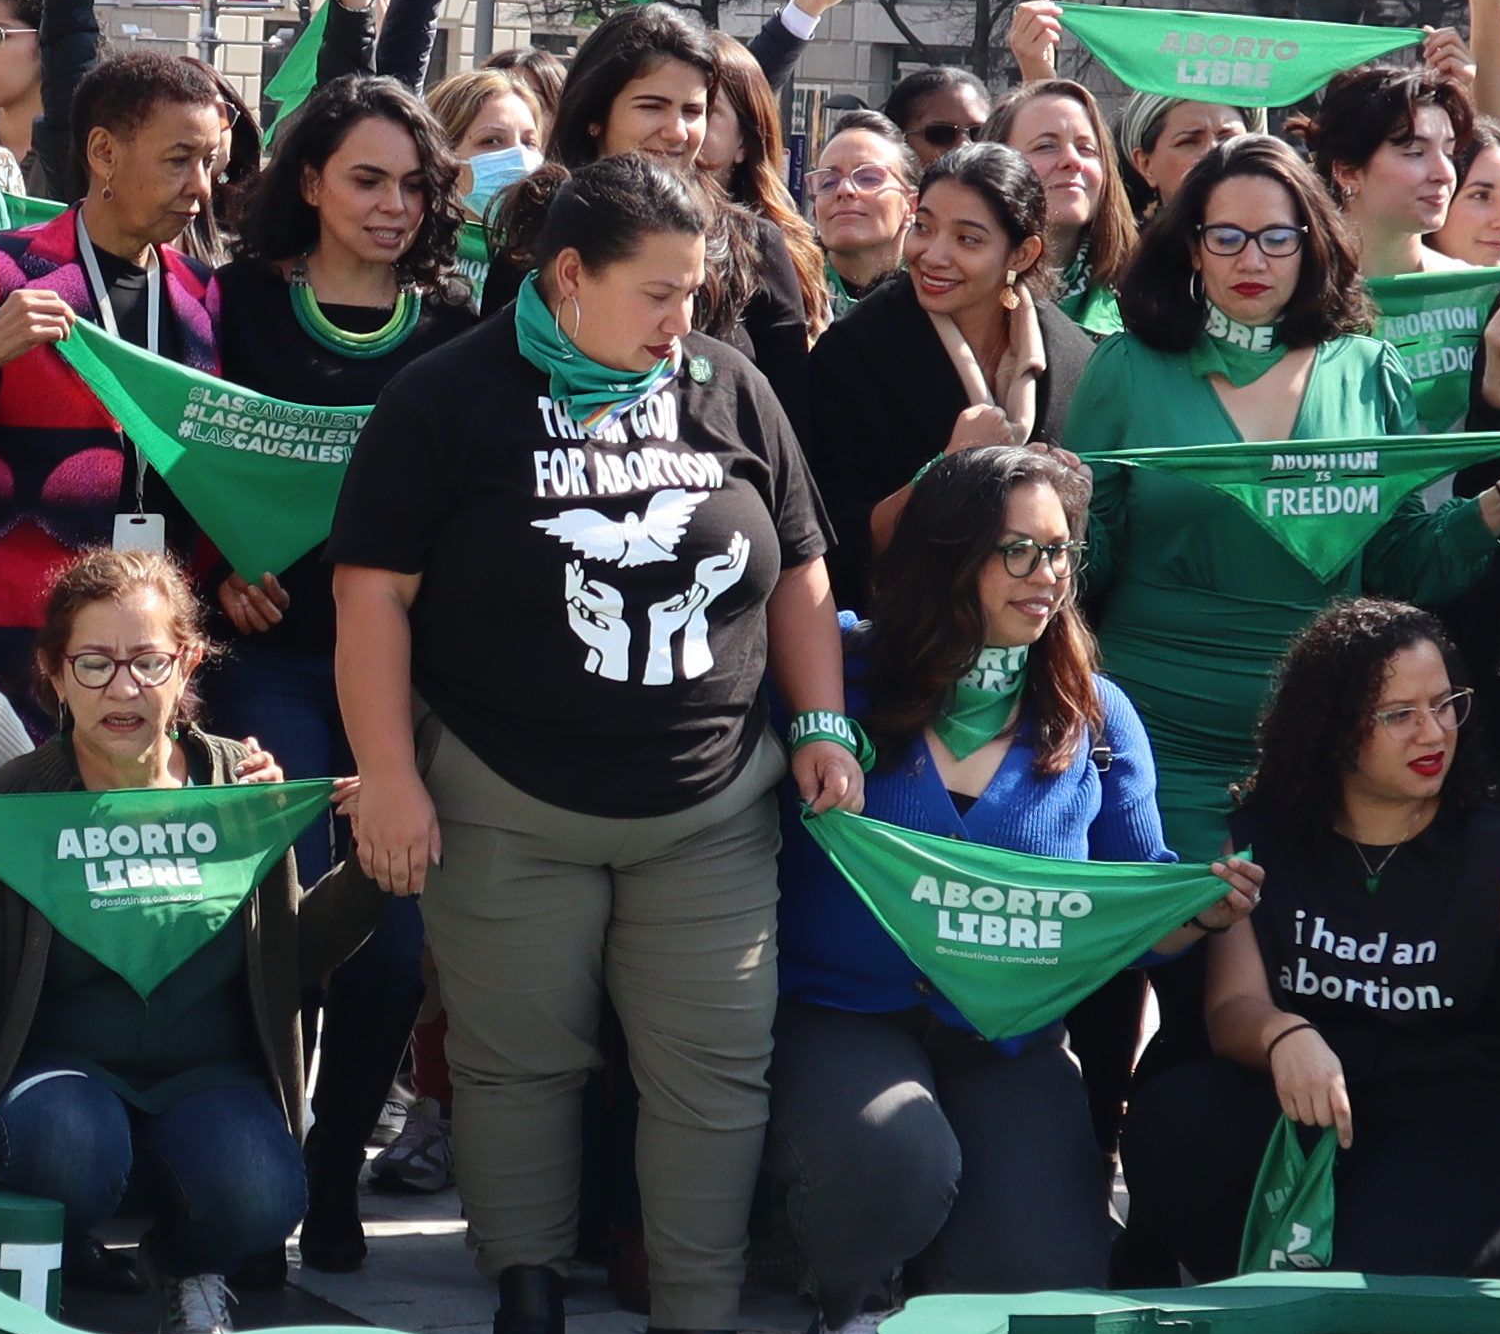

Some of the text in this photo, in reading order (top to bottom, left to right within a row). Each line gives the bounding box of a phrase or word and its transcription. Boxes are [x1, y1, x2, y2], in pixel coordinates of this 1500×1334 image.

[1158, 32, 1300, 61] ABORTO
[1176, 58, 1274, 88] LIBRE
[1384, 306, 1479, 341] ABORTION
[1429, 335, 1445, 346] IS
[629, 391, 678, 442] GOD
[533, 447, 724, 497] FOR ABORTION
[1314, 470, 1332, 483] IS
[1265, 484, 1379, 517] FREEDOM
[57, 822, 218, 860] ABORTO
[84, 857, 204, 893] LIBRE
[910, 874, 1093, 919] ABORTO
[937, 909, 1063, 950] LIBRE
[1294, 910, 1438, 965] i had an
[1278, 957, 1454, 1012] abortion.
